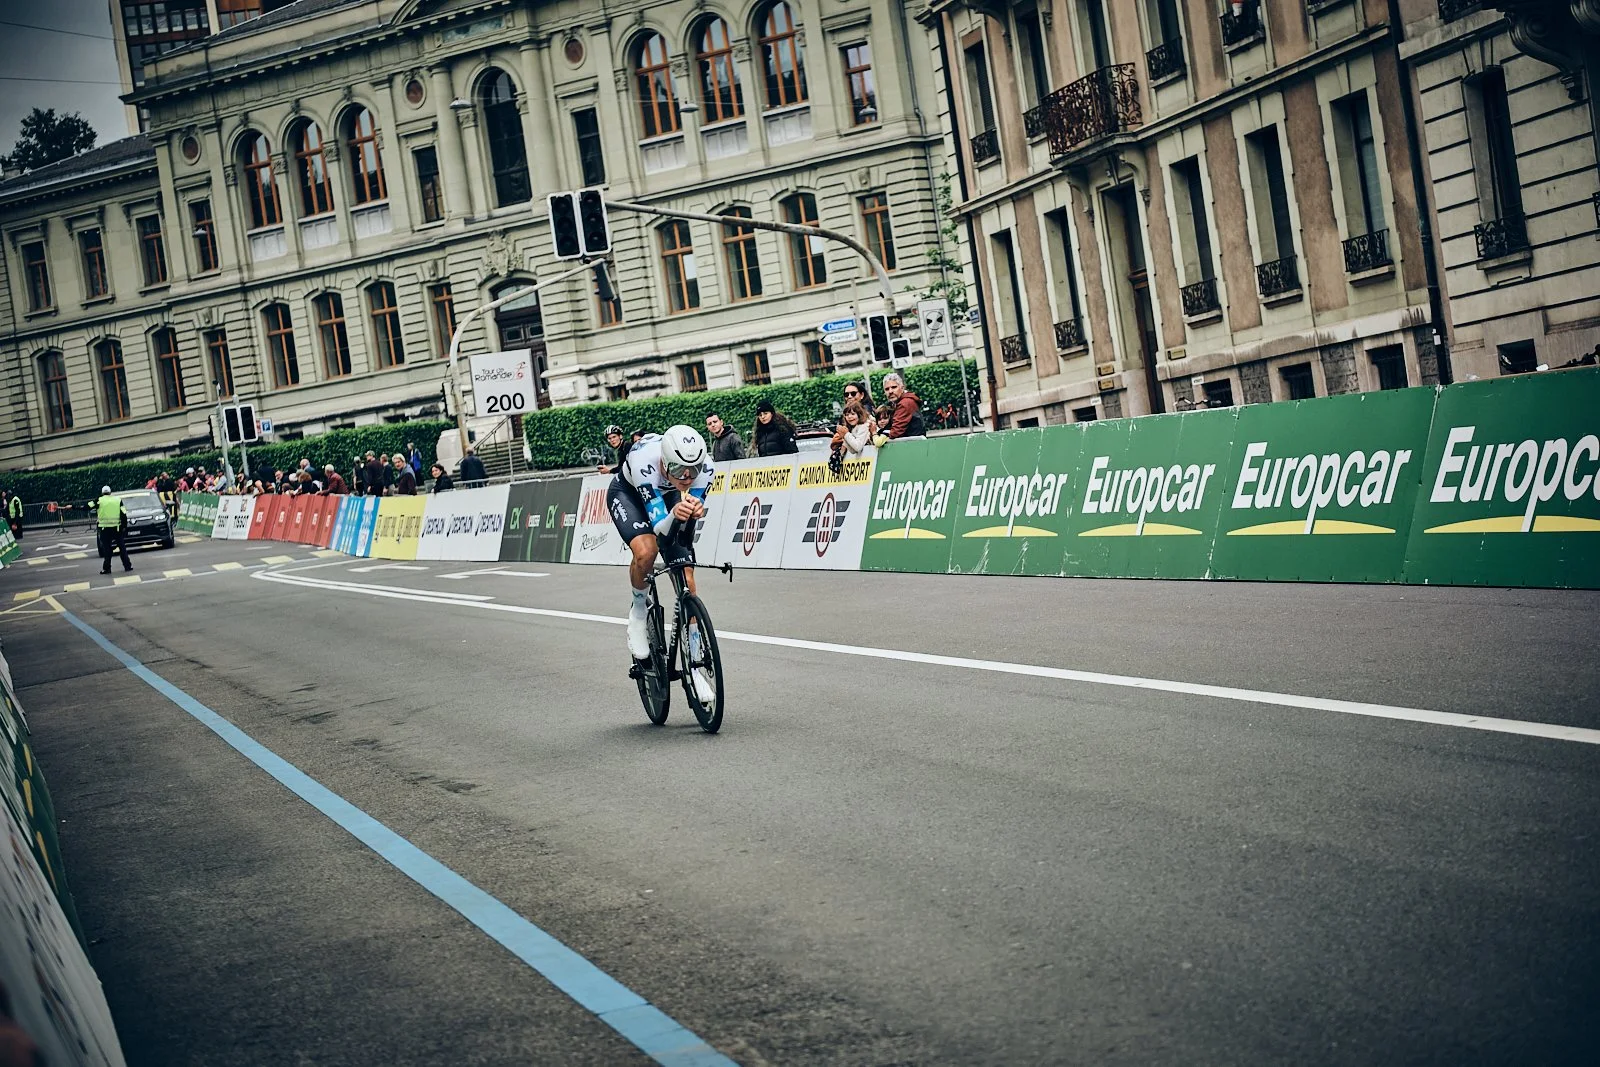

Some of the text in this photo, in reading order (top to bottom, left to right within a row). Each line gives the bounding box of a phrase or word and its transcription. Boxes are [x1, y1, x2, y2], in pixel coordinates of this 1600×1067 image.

[475, 372, 512, 381] Romandie
[486, 393, 525, 413] 200
[731, 472, 755, 490] CAMION
[755, 468, 791, 488] TRANSPORT
[799, 465, 826, 485] CAMION
[872, 471, 955, 539] Europcar
[965, 464, 1068, 538] Europcar
[1082, 456, 1216, 536] Europcar
[1231, 442, 1412, 534] Europcar
[1430, 426, 1600, 533] Europc
